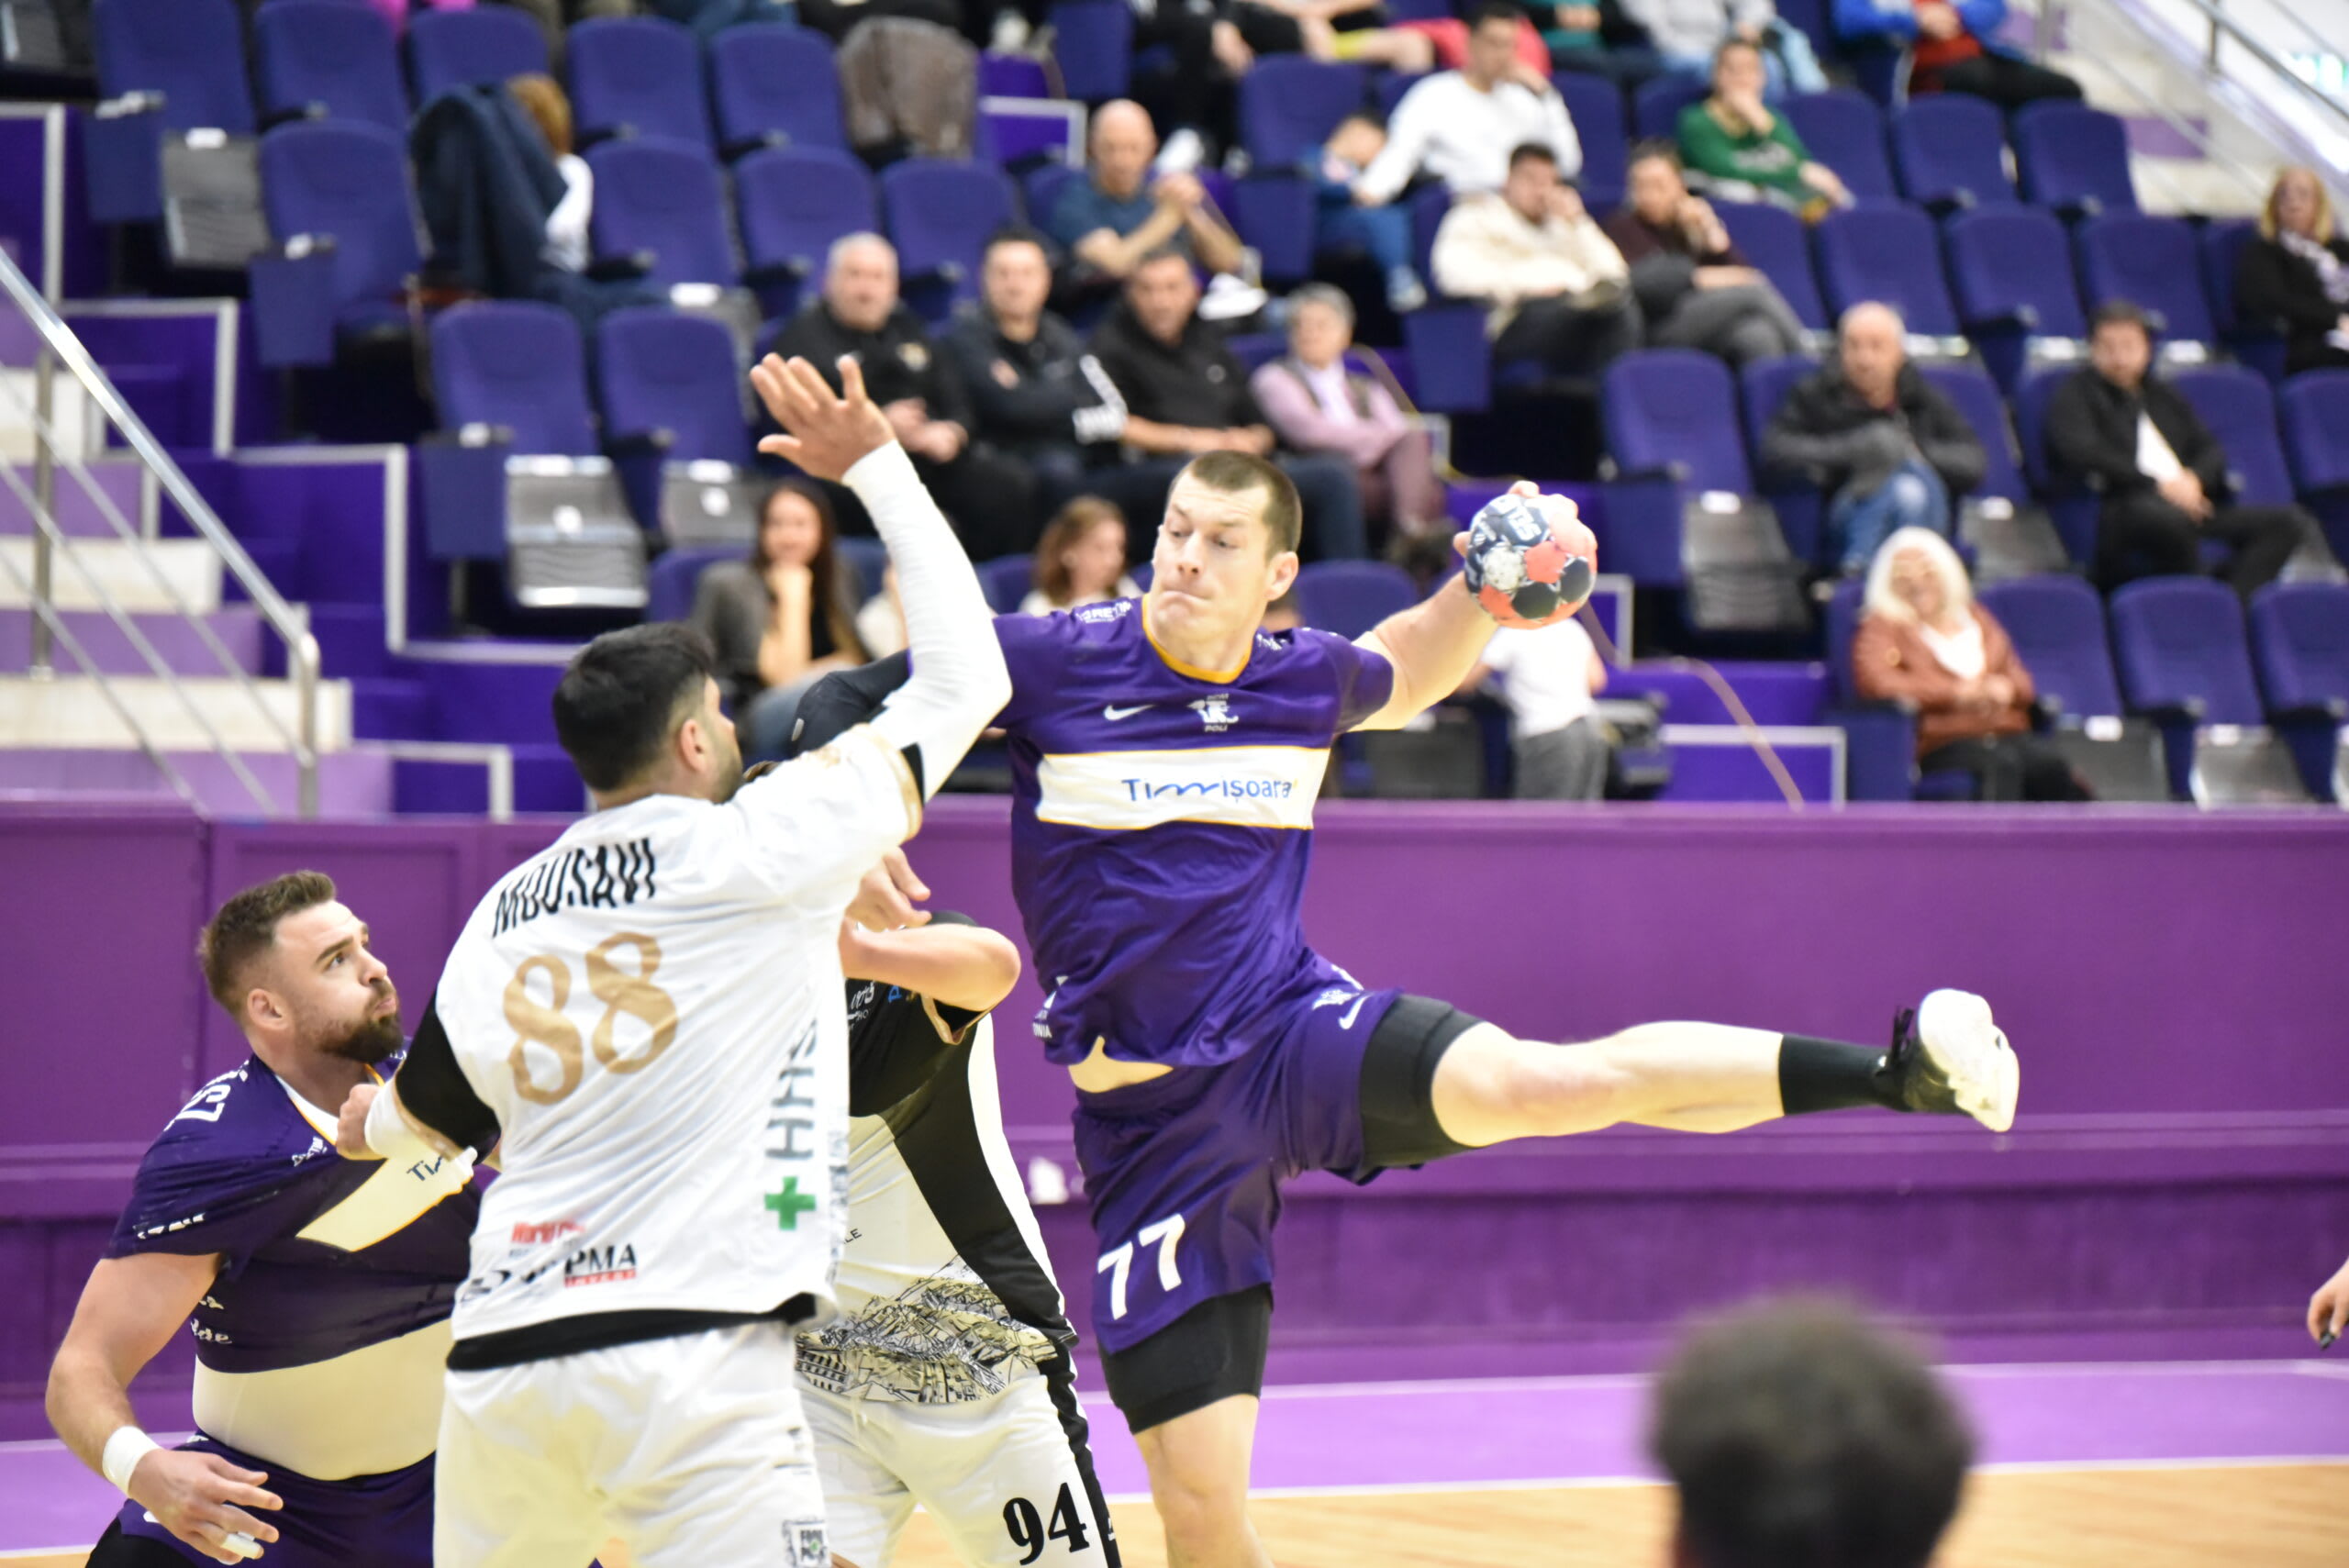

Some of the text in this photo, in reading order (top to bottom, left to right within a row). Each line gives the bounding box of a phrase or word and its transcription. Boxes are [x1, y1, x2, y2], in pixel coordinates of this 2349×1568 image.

[502, 931, 680, 1106] 88
[564, 1242, 637, 1275] PMA
[1097, 1213, 1186, 1321] 77
[1002, 1482, 1090, 1566] 94
